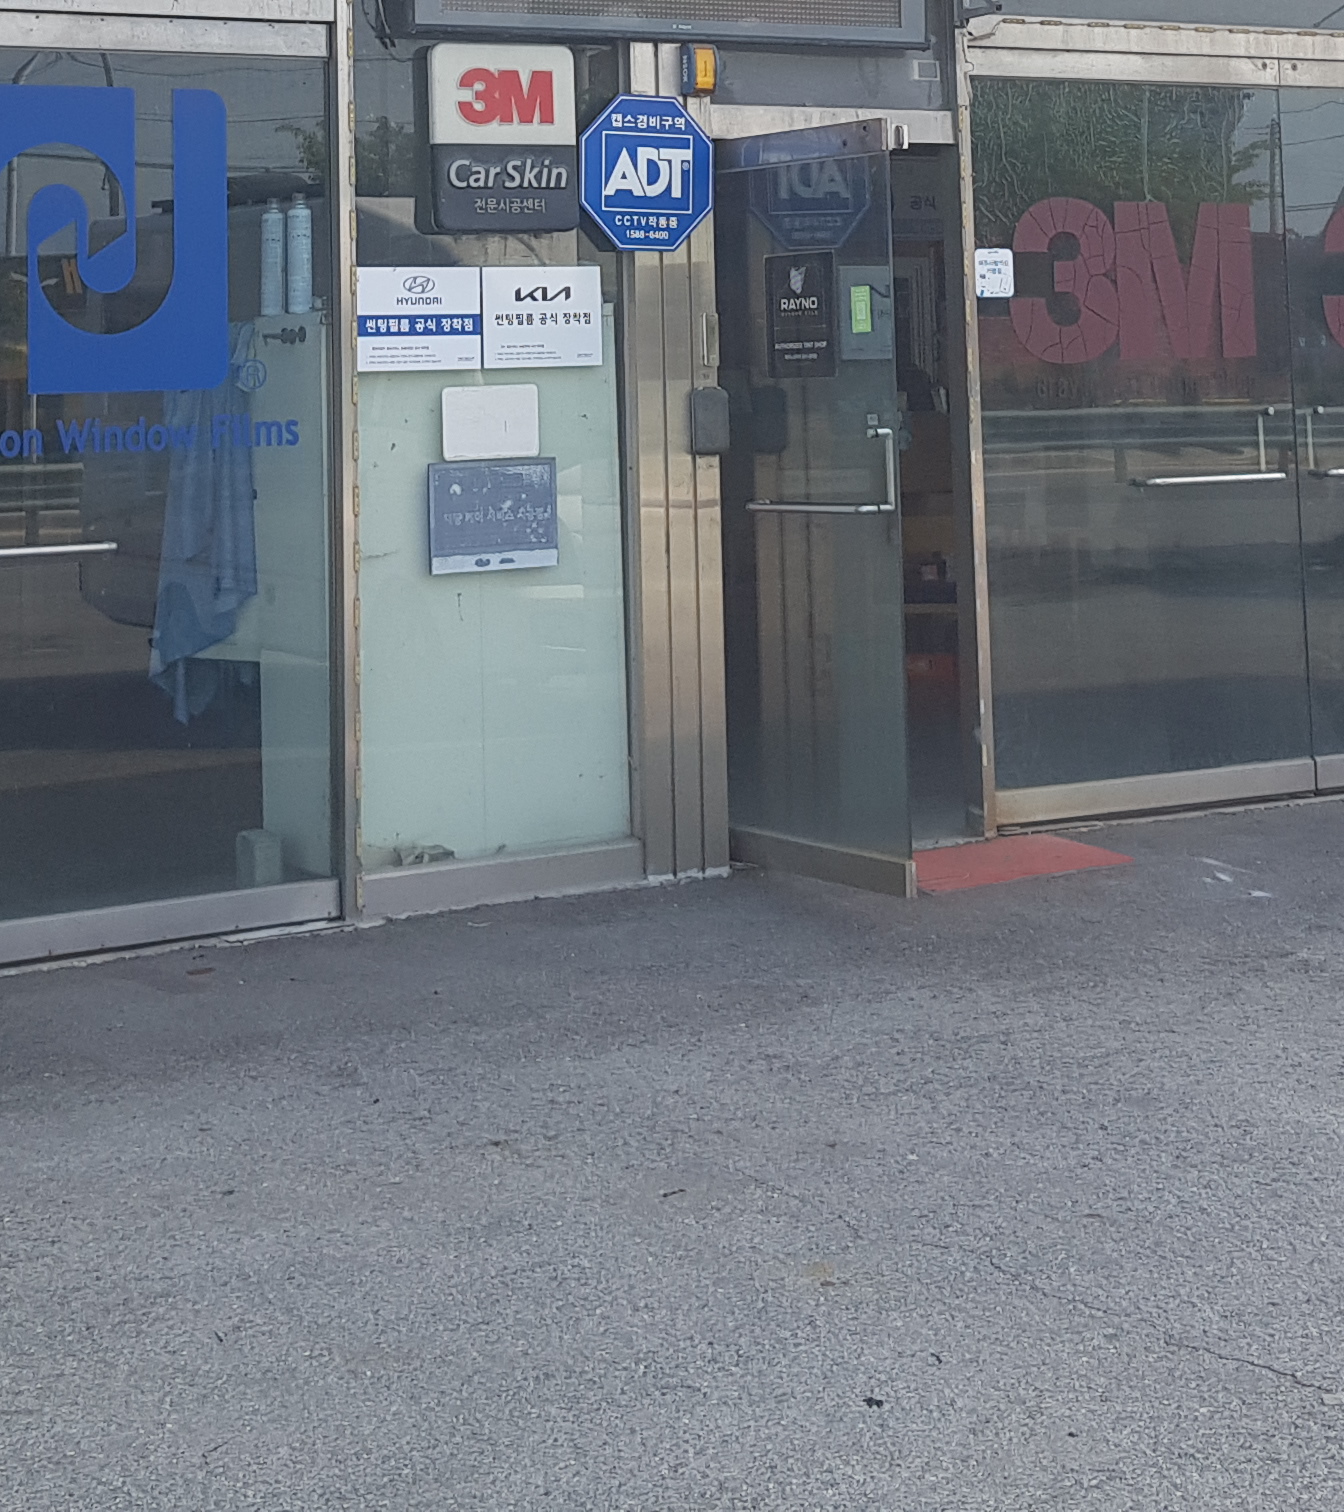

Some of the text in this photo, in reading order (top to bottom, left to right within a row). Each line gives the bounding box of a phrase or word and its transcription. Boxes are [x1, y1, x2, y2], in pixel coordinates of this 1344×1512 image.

[457, 67, 555, 125] 3M
[610, 113, 686, 131] 캡스경비구역
[604, 146, 693, 199] ADT
[474, 197, 546, 214] 전문시공센터
[1009, 196, 1257, 364] 3M
[396, 296, 443, 306] HYUNDAI
[780, 296, 818, 311] RAYNO
[365, 318, 474, 333] 썬팅필름 공식 장착점
[539, 312, 558, 325] 공식
[56, 415, 198, 455] Window
[210, 412, 300, 450] Films
